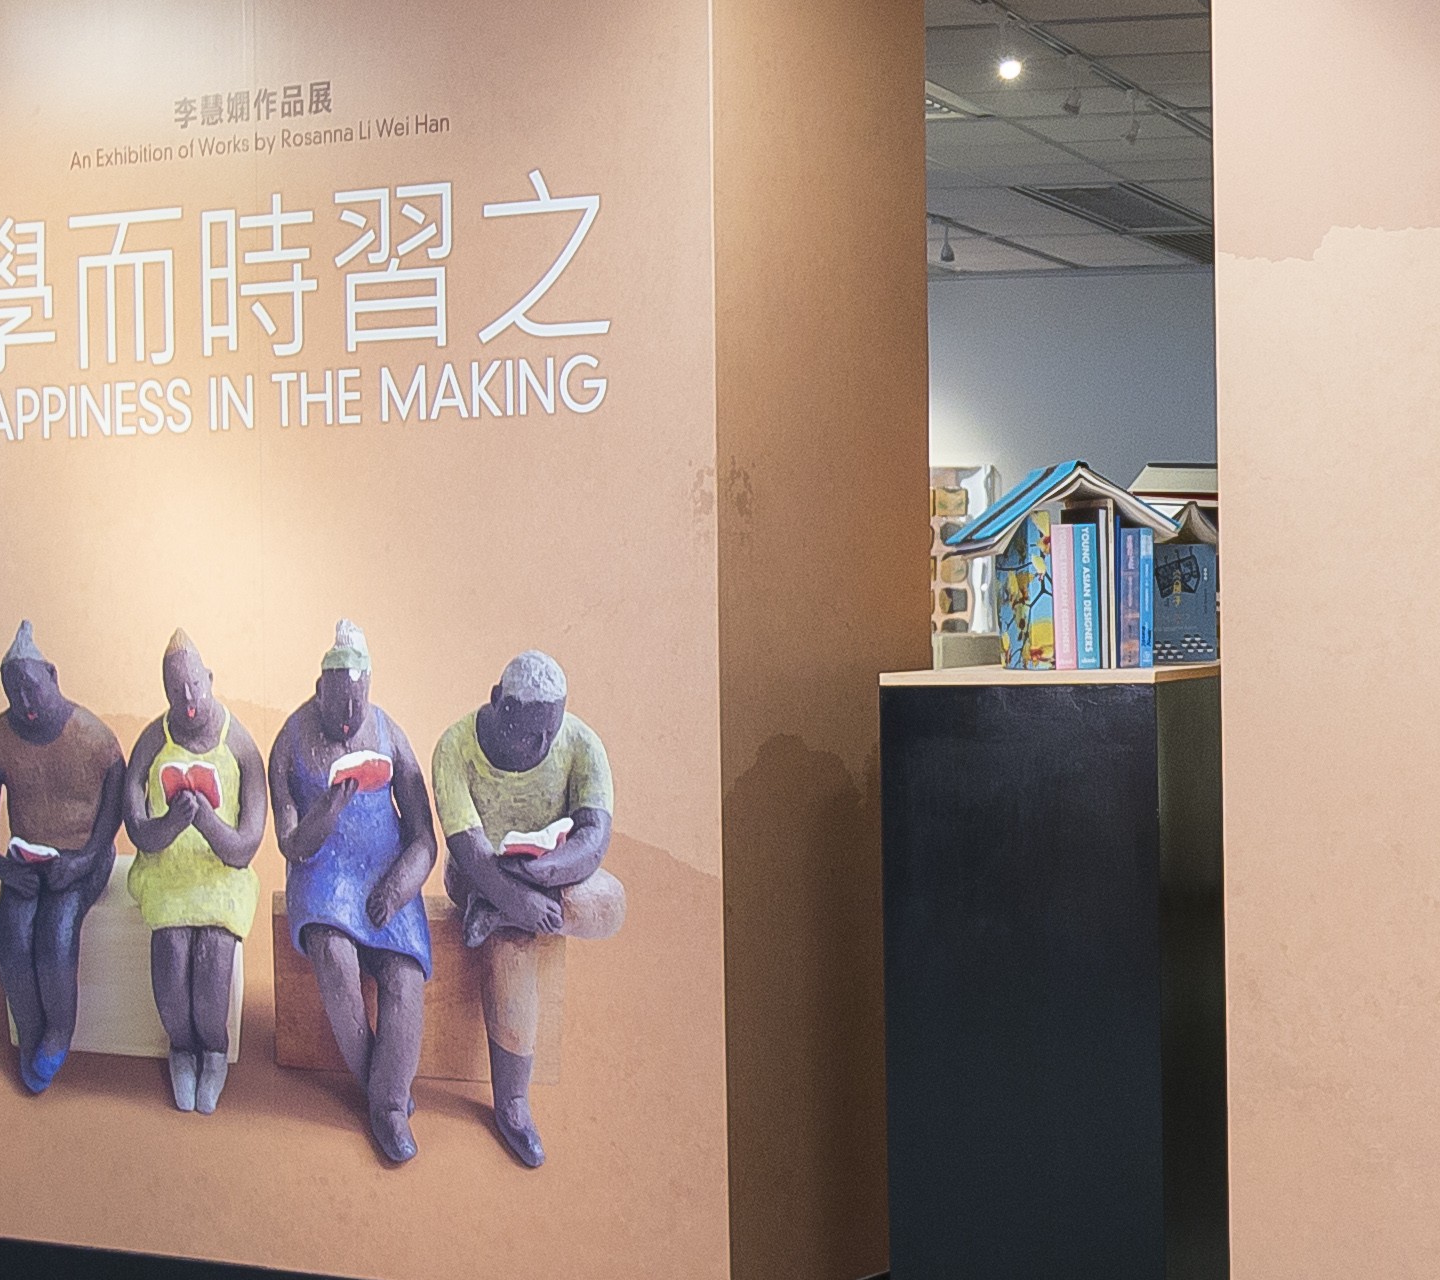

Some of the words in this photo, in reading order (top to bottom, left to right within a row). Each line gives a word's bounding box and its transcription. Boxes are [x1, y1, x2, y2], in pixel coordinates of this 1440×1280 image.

[70, 150, 92, 170] An
[96, 142, 173, 169] Exhibition
[177, 139, 196, 159] of
[197, 135, 250, 157] Works
[254, 131, 277, 154] by
[281, 124, 354, 149] Rosanna
[359, 120, 372, 141] Li
[375, 116, 410, 139] Wei
[415, 114, 451, 135] Han
[208, 374, 255, 432] IN
[271, 367, 362, 428] THE
[380, 353, 608, 423] MAKING
[1081, 527, 1091, 564] YOUNG
[1082, 567, 1092, 598] ASIAN
[1083, 600, 1094, 653] DESIGNERS
